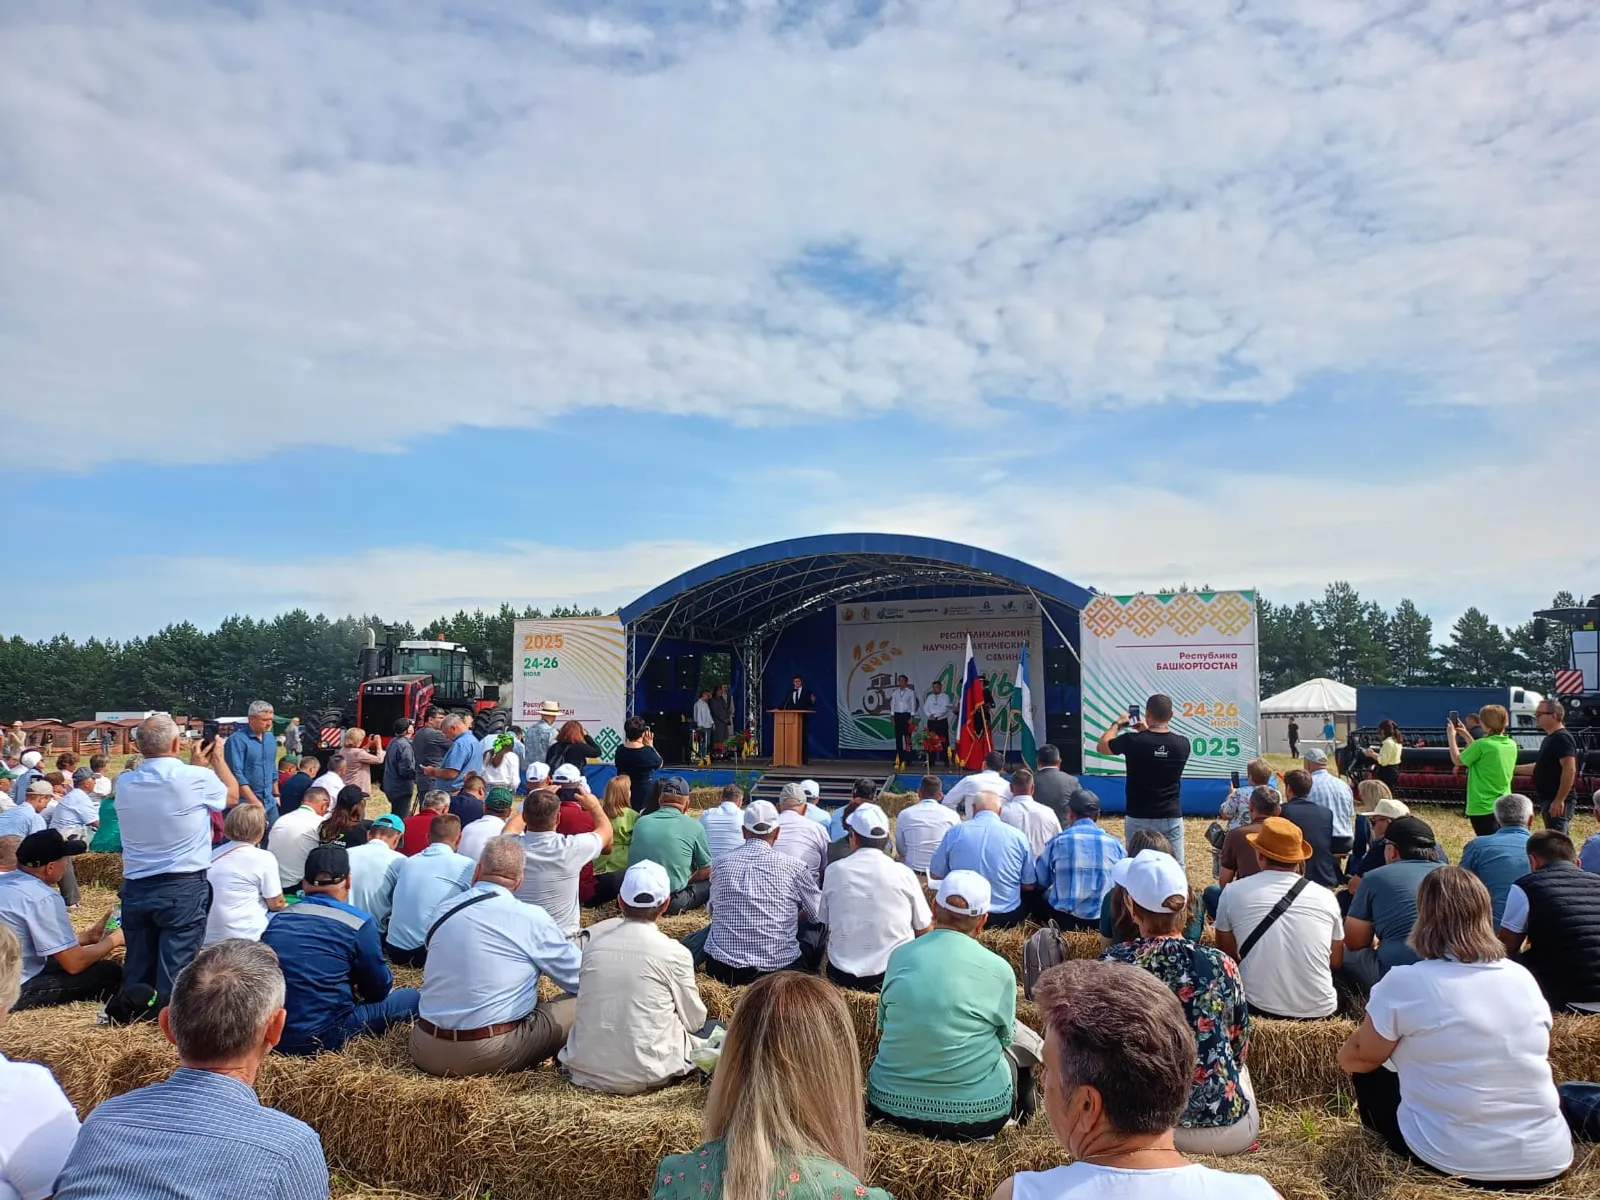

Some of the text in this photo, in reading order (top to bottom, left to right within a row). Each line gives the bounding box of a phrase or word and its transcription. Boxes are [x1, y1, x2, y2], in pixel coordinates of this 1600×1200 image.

[940, 629, 1031, 640] РЕСПУБЛИКАНСКИЙ
[524, 633, 564, 650] 2025
[922, 639, 1030, 652] НАУЧНО-ПАКТИЧЕСКИЙ
[523, 656, 559, 669] 24-26
[1179, 652, 1238, 662] Республика
[1156, 662, 1238, 671] БАШКОРТОСТАН
[1182, 701, 1238, 718] 24-26
[1191, 736, 1241, 758] 025
